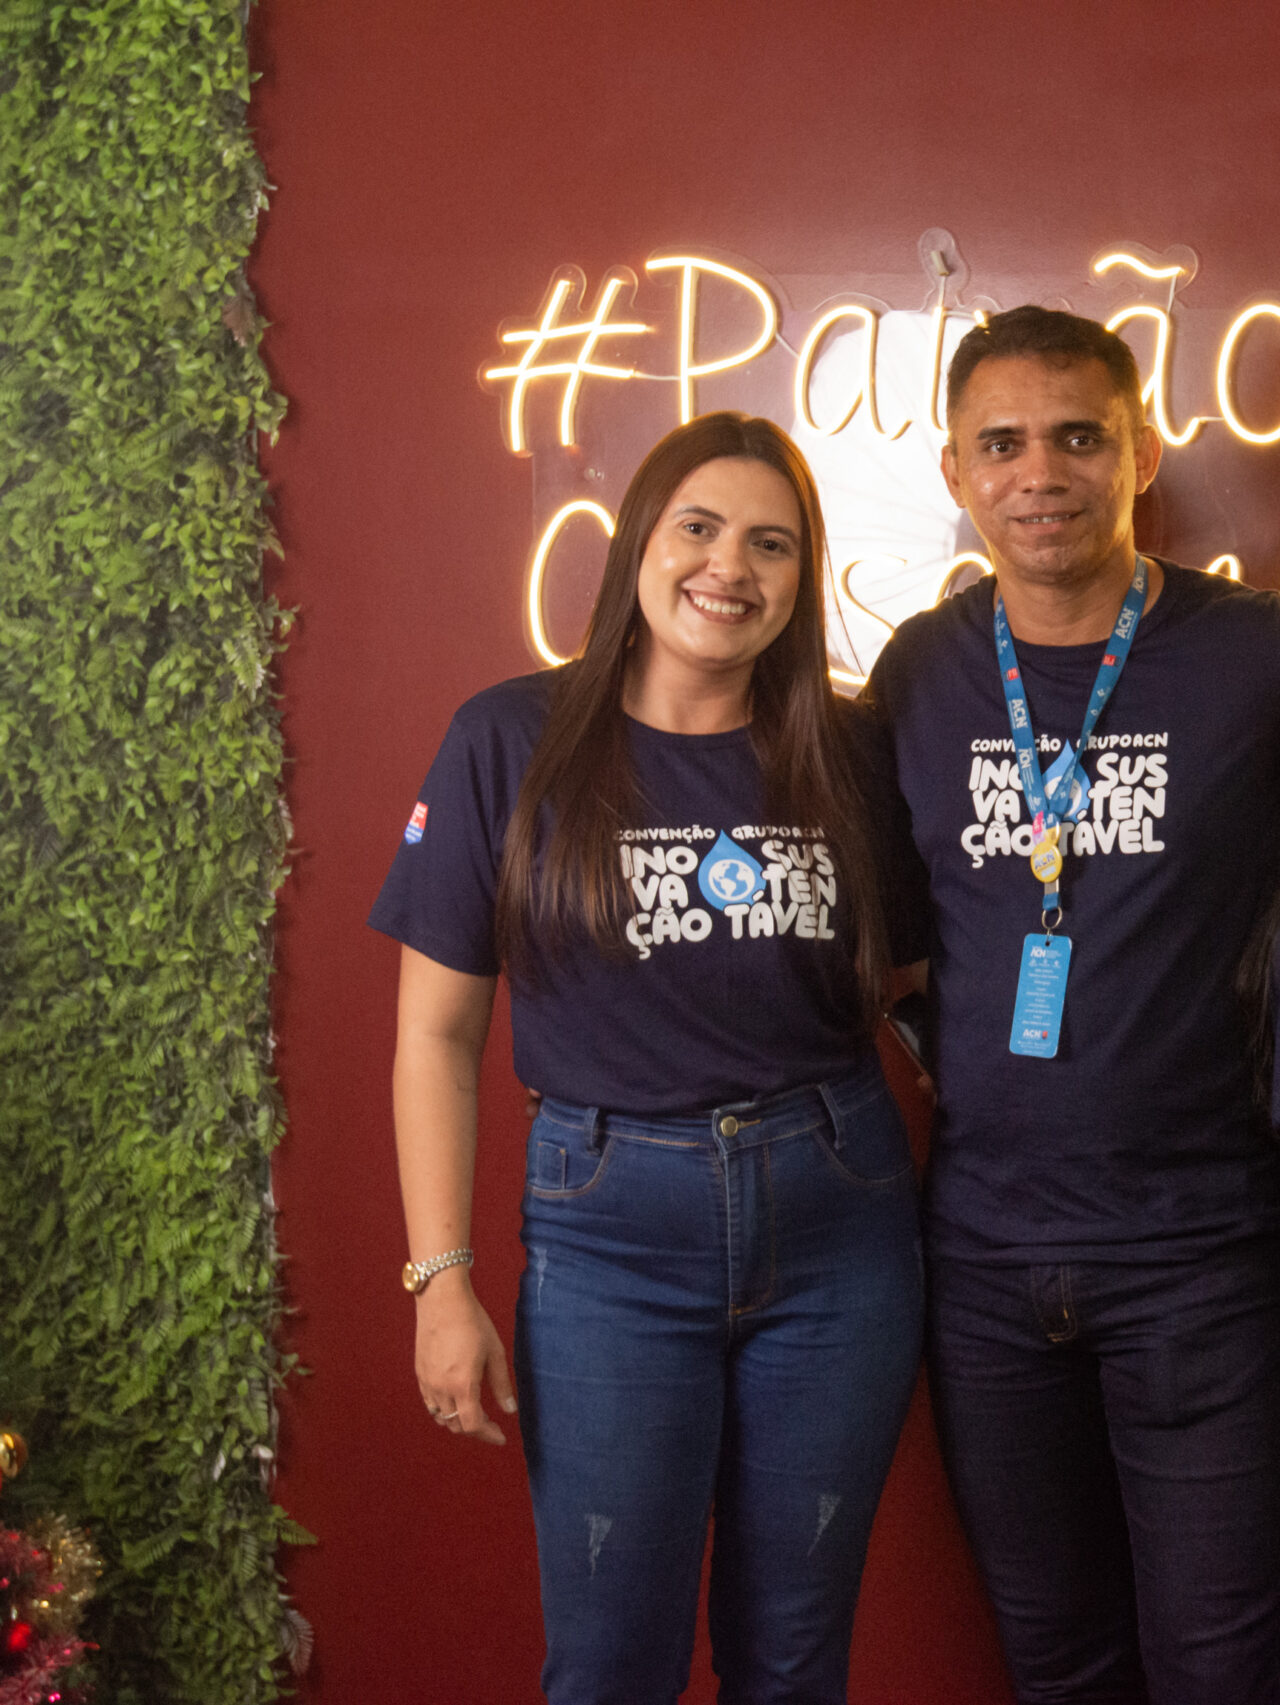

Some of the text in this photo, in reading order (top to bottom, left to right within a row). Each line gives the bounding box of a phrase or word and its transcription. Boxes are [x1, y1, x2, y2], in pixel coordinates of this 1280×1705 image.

[1115, 606, 1135, 639] ACN
[1012, 699, 1028, 729] ACN
[971, 733, 1061, 752] CONVÃO
[1096, 752, 1169, 788] SUS
[972, 789, 1021, 823] VA
[1088, 781, 1166, 821] TEN
[961, 820, 1034, 869] ÇÃO
[1058, 809, 1165, 856] TÁVEL
[620, 844, 699, 879] INO
[761, 839, 835, 876] SUS
[631, 874, 689, 911] VA
[761, 863, 837, 908] TEN
[625, 907, 713, 960] ÇÃO
[723, 890, 836, 940] TÁVEL
